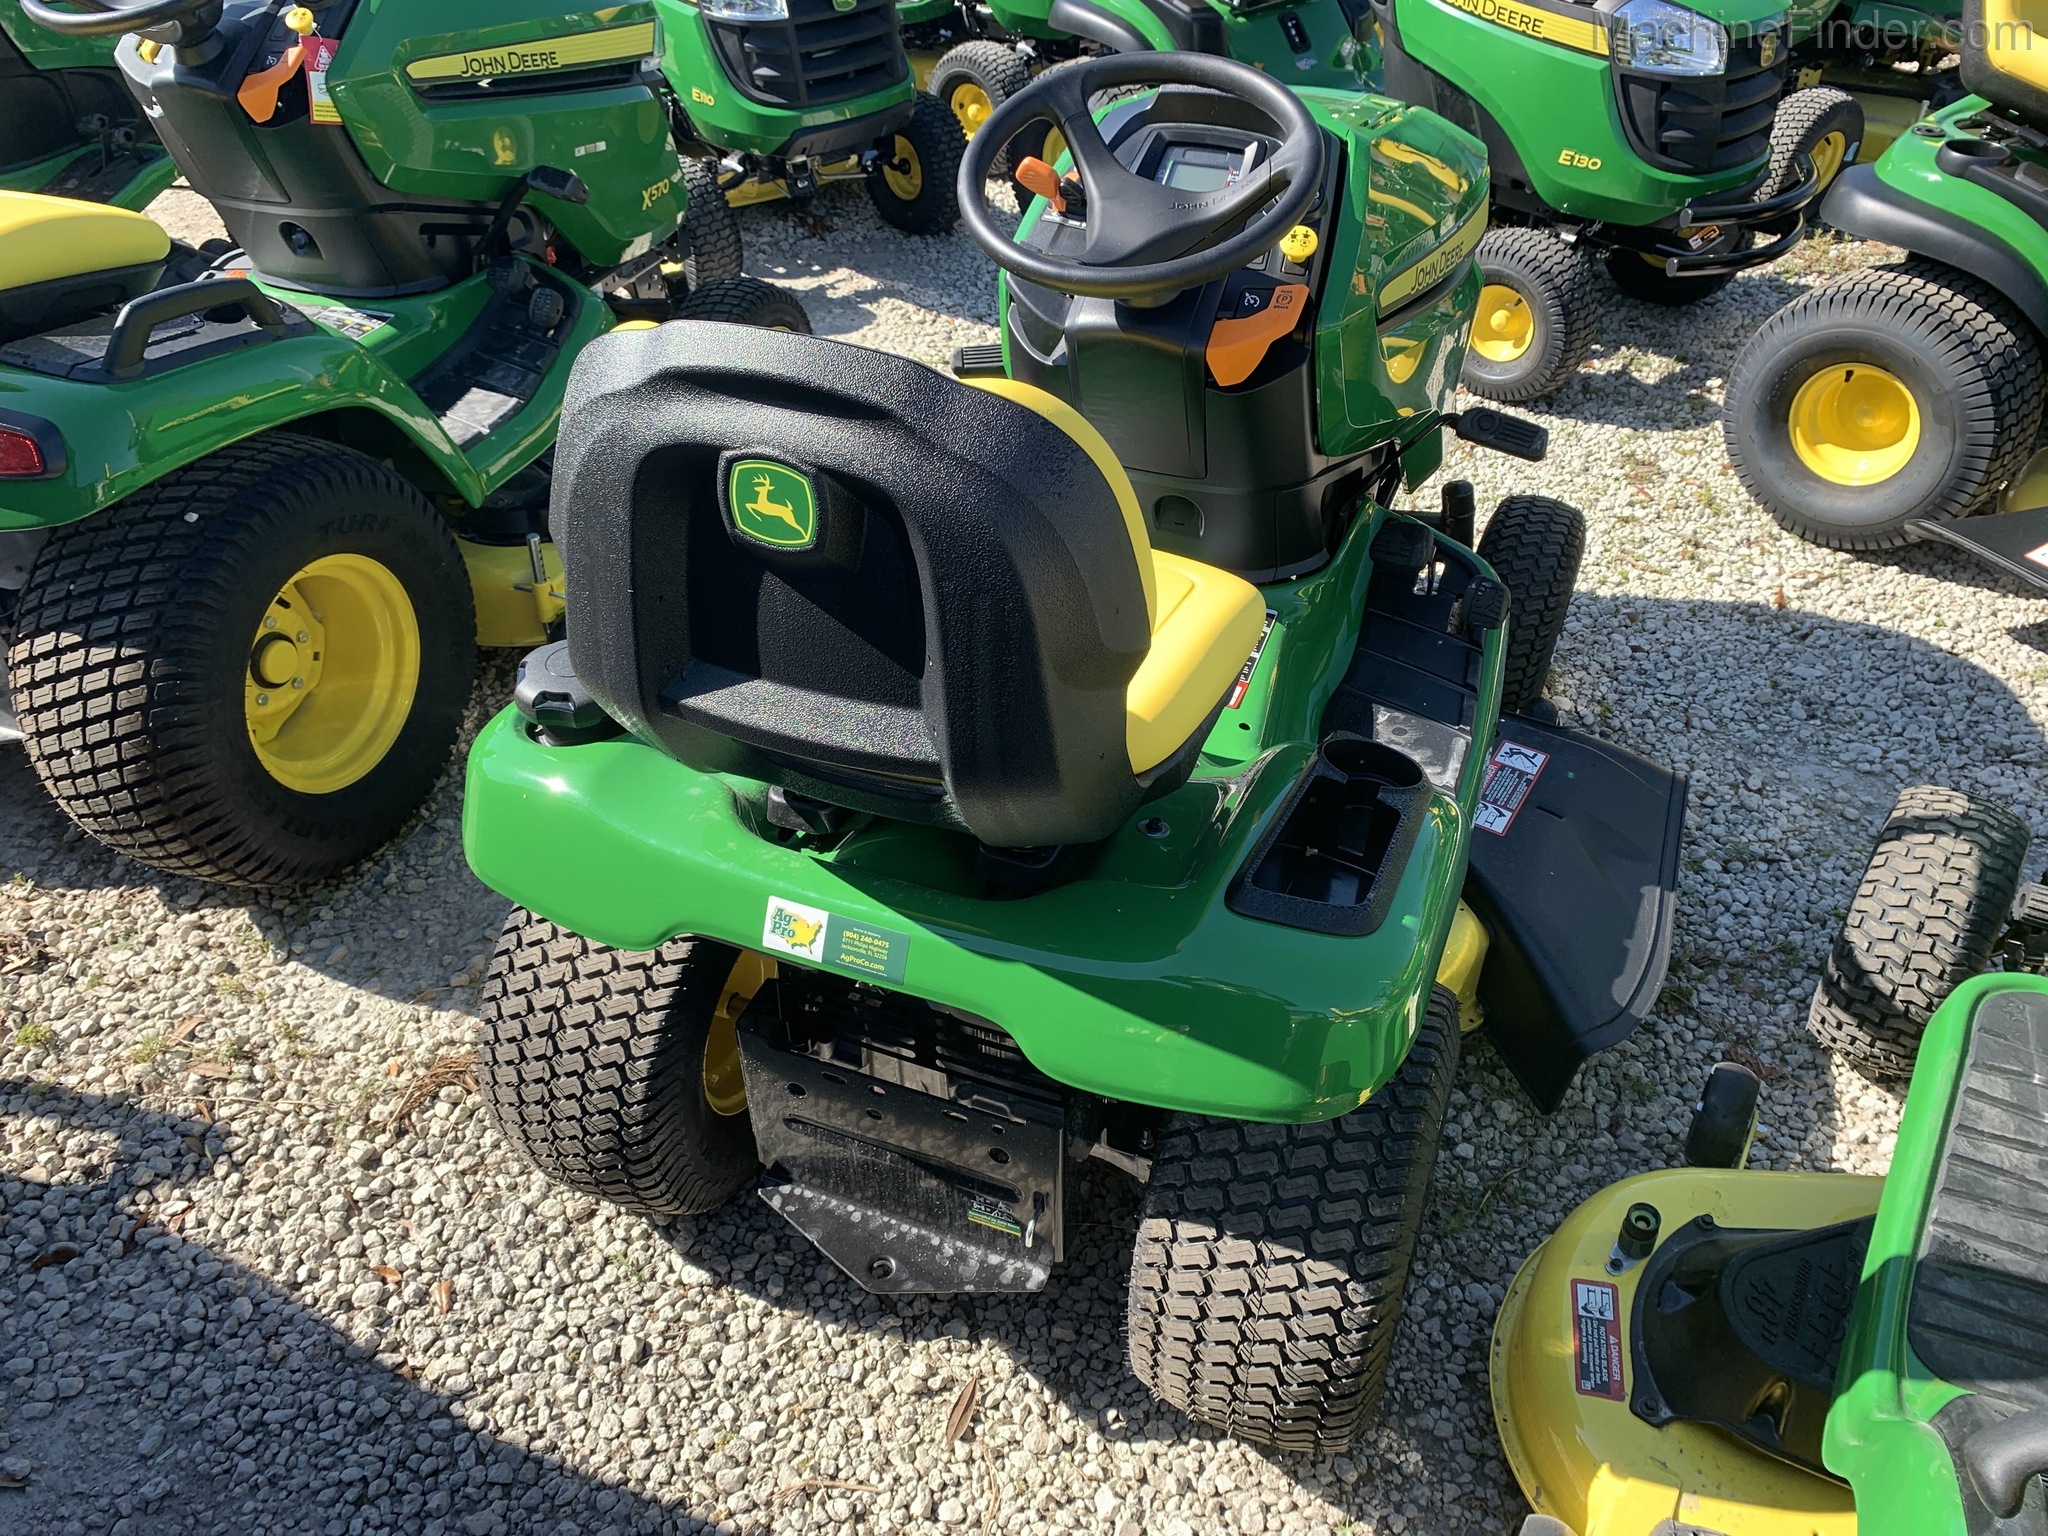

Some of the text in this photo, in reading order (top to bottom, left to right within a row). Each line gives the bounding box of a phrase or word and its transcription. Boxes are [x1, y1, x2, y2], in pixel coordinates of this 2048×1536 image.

[1482, 0, 1544, 34] DEERE
[460, 51, 559, 75] JOHN DEERE
[1558, 149, 1602, 170] E130
[641, 178, 670, 211] X570
[1168, 201, 1209, 210] JOHN
[1410, 241, 1464, 292] JOHN DEERE
[770, 922, 796, 939] Pro
[843, 930, 890, 948] (904) 240-0475
[868, 945, 888, 955] Highway
[840, 952, 886, 972] AgProCo.com
[1593, 1320, 1598, 1328] Do
[1610, 1345, 1620, 1380] DANGER
